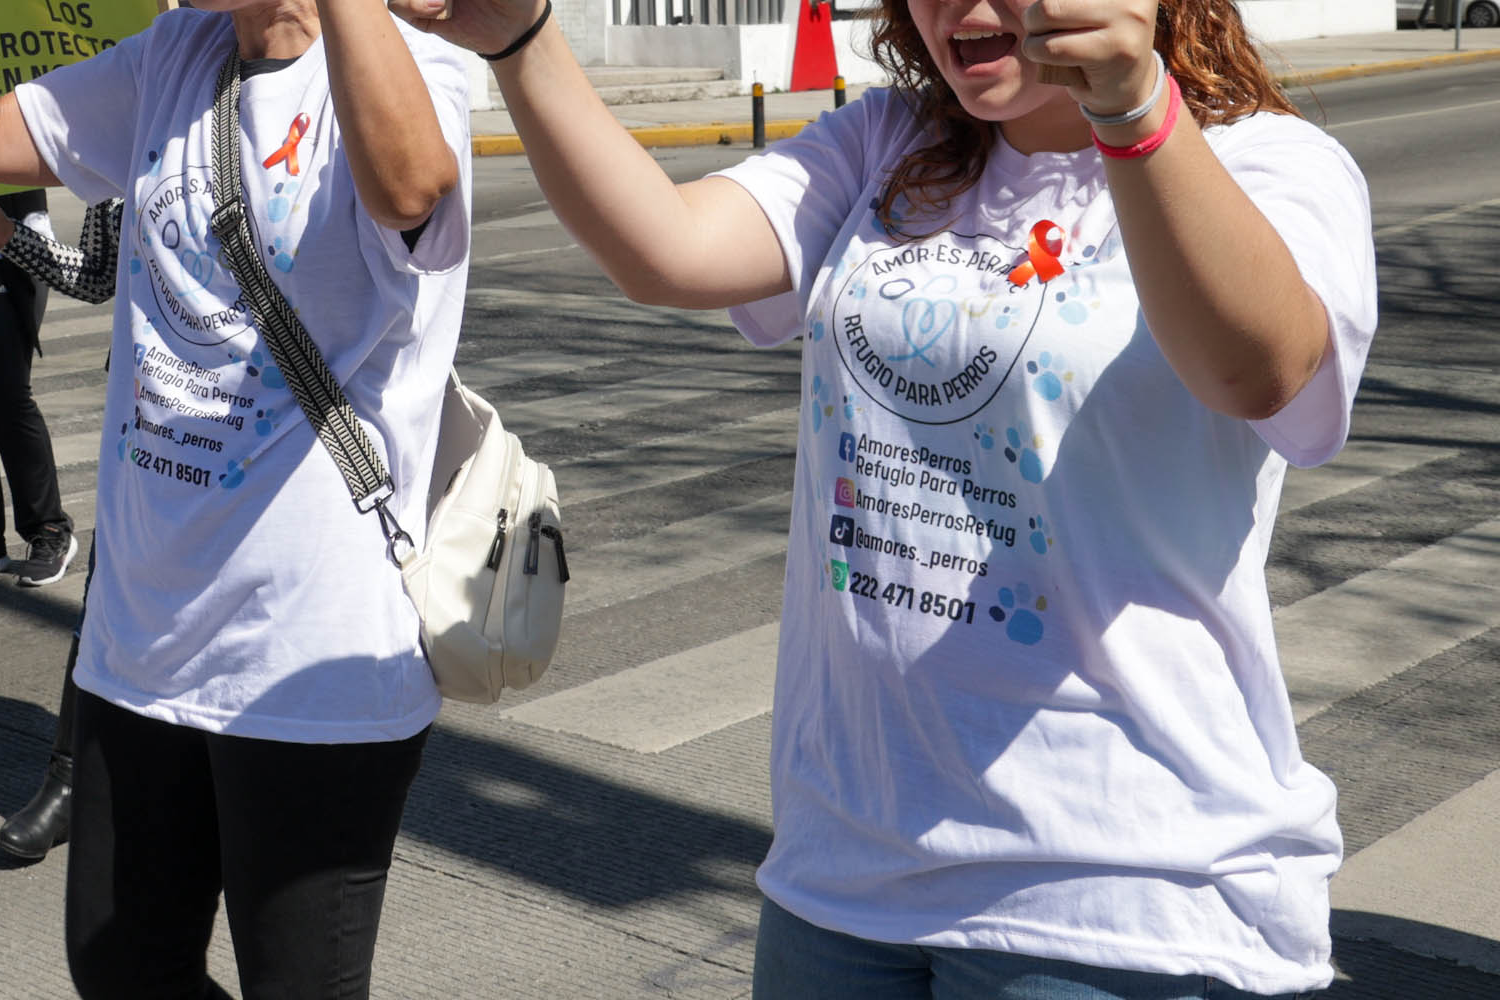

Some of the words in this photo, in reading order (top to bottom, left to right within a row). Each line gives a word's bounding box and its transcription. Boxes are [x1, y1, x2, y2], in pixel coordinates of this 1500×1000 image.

[141, 360, 184, 389] Refugio
[184, 378, 209, 399] Para
[212, 386, 255, 409] Perros
[146, 346, 222, 384] AmoresPerros
[844, 313, 894, 389] REFUGIO
[894, 376, 943, 407] PARA
[942, 345, 998, 405] PERROS
[139, 385, 245, 432] AmoresPerrosRefug
[153, 455, 173, 478] 471
[175, 462, 212, 488] 8501
[857, 433, 972, 476] AmoresPerros
[856, 455, 915, 488] Refugio
[919, 470, 957, 496] Para
[962, 479, 1017, 509] Perros
[856, 488, 1016, 548] AmoresPerrosRefug
[855, 526, 989, 578] @amores._perros
[849, 571, 878, 601] 222
[882, 583, 915, 610] 471
[919, 591, 976, 625] 8501
